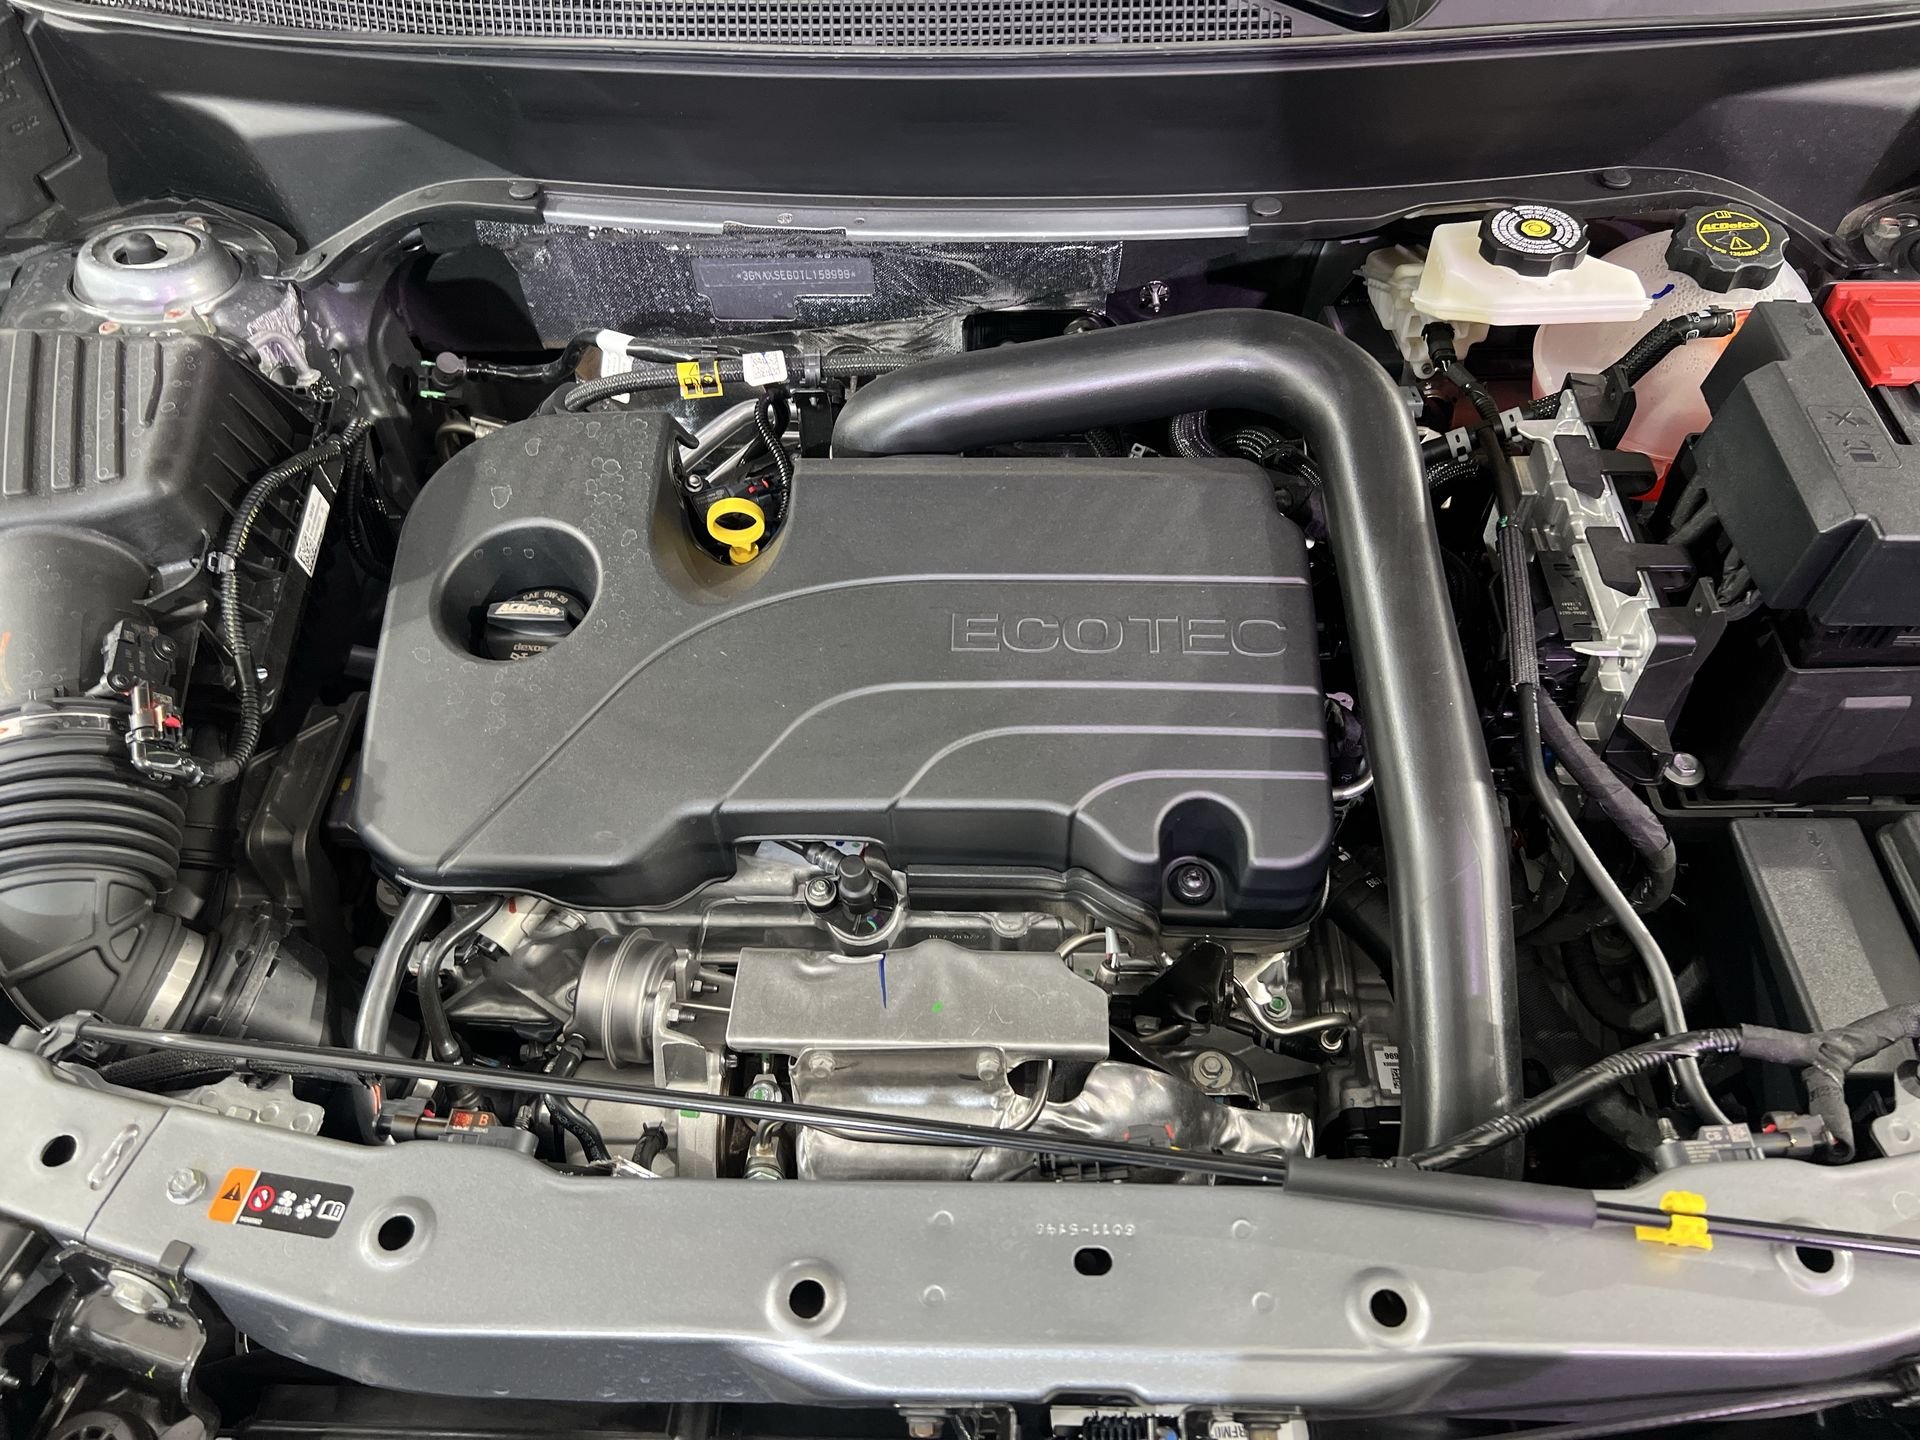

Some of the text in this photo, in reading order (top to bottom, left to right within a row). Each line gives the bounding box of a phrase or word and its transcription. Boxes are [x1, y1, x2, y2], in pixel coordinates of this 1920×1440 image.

[1701, 221, 1760, 232] ACDelco
[495, 603, 561, 615] ACDelco
[950, 612, 1289, 657] ECOTEC
[478, 1114, 489, 1126] B
[272, 1205, 292, 1216] AUTO
